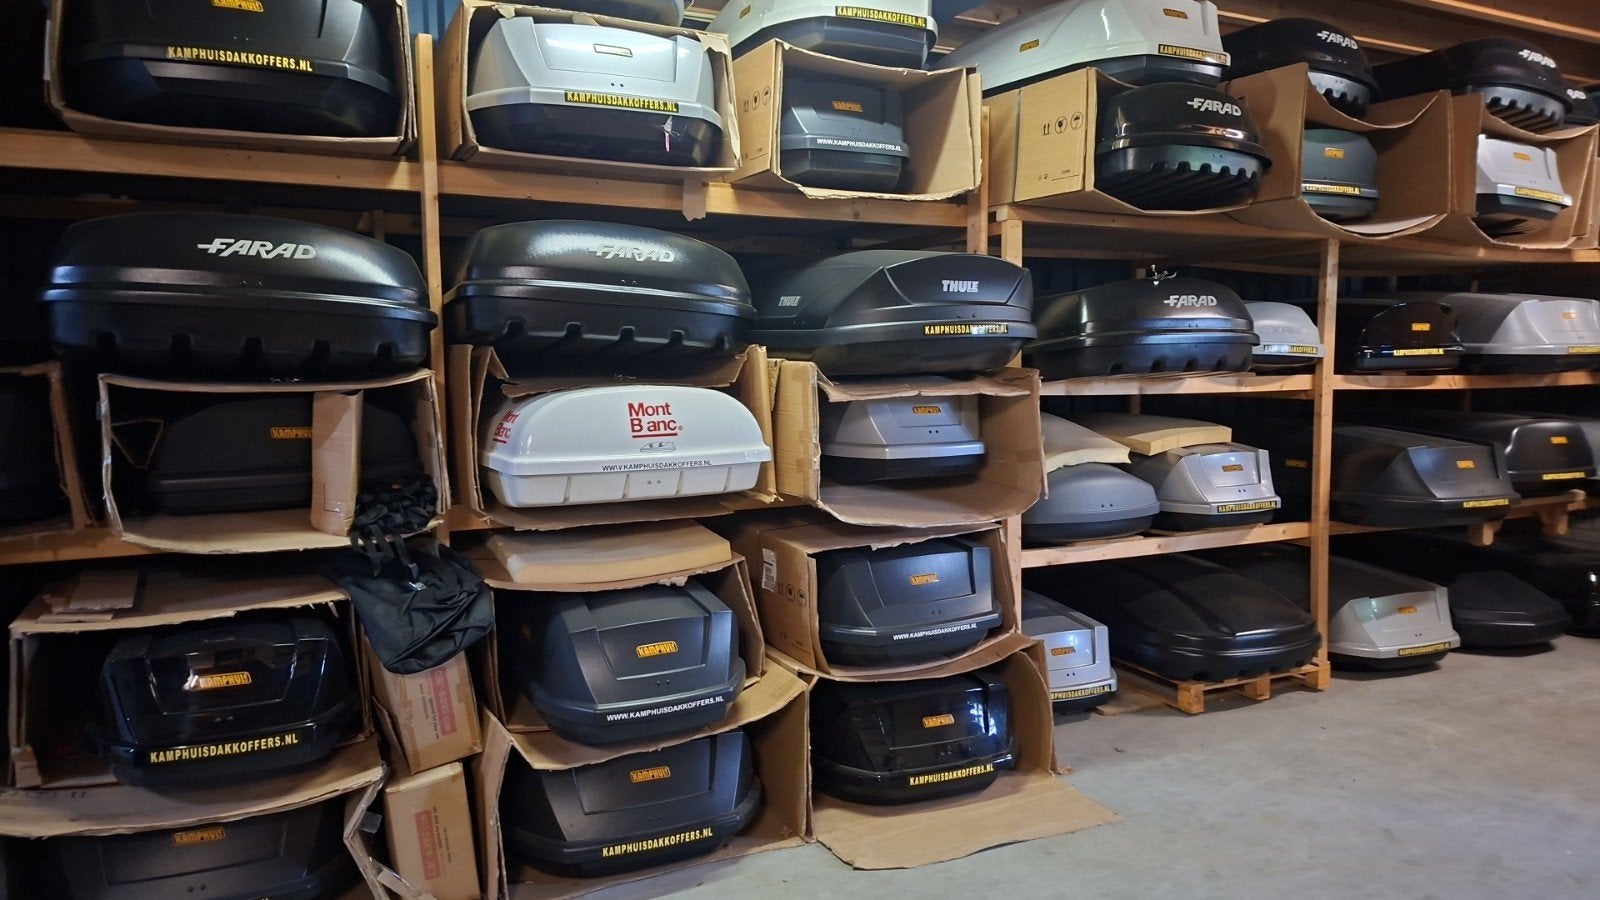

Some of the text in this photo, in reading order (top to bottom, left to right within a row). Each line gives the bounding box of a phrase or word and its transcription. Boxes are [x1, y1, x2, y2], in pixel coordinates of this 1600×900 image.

[834, 6, 928, 27] KAMPHUISDAKKOFFERS.NL
[1317, 30, 1358, 49] FARAD
[167, 46, 313, 72] KAMPHUISDAKKOFFERS.NL
[567, 92, 677, 112] KAMPHUISDAKKOFFERS.NL
[1187, 97, 1242, 116] FARAD
[197, 238, 317, 260] FARAD
[588, 242, 675, 263] FARAD
[942, 280, 979, 293] THULE
[1163, 295, 1218, 308] FARAD
[628, 402, 672, 417] Mont
[272, 427, 312, 439] KAMPHUI
[606, 696, 724, 722] WWW.KAMPHUISDAKKOFFERS.NL
[150, 736, 299, 763] KAMPHUISDAKKOFFERS.NL
[909, 764, 994, 786] KAMPHUISDAKKOFFERS.NL
[602, 828, 713, 857] KAMPHUISDAKKOFFERS.NL
